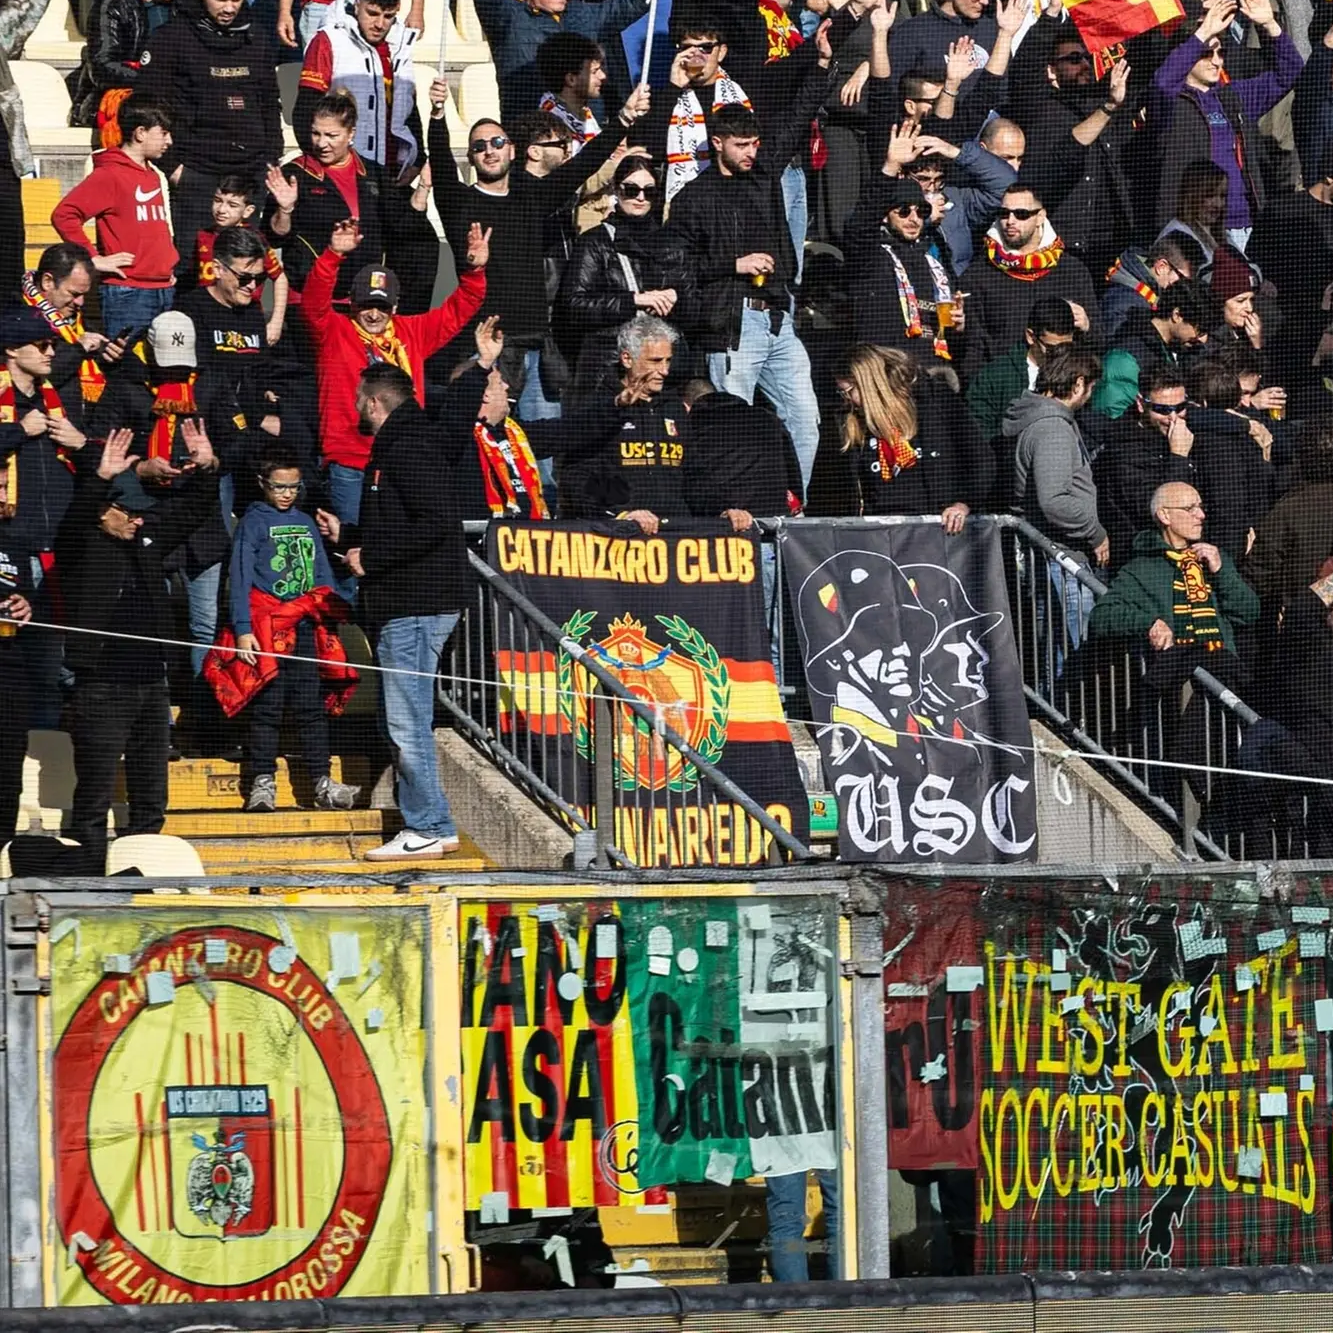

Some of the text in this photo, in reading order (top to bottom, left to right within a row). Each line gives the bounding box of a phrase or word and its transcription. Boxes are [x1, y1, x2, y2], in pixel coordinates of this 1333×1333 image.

[496, 525, 757, 585] CATANZARO CLUB
[834, 772, 1037, 857] USC
[983, 940, 1142, 1077] WEST
[1158, 937, 1309, 1077] GATE
[979, 1083, 1317, 1224] SOCCER CASUALS
